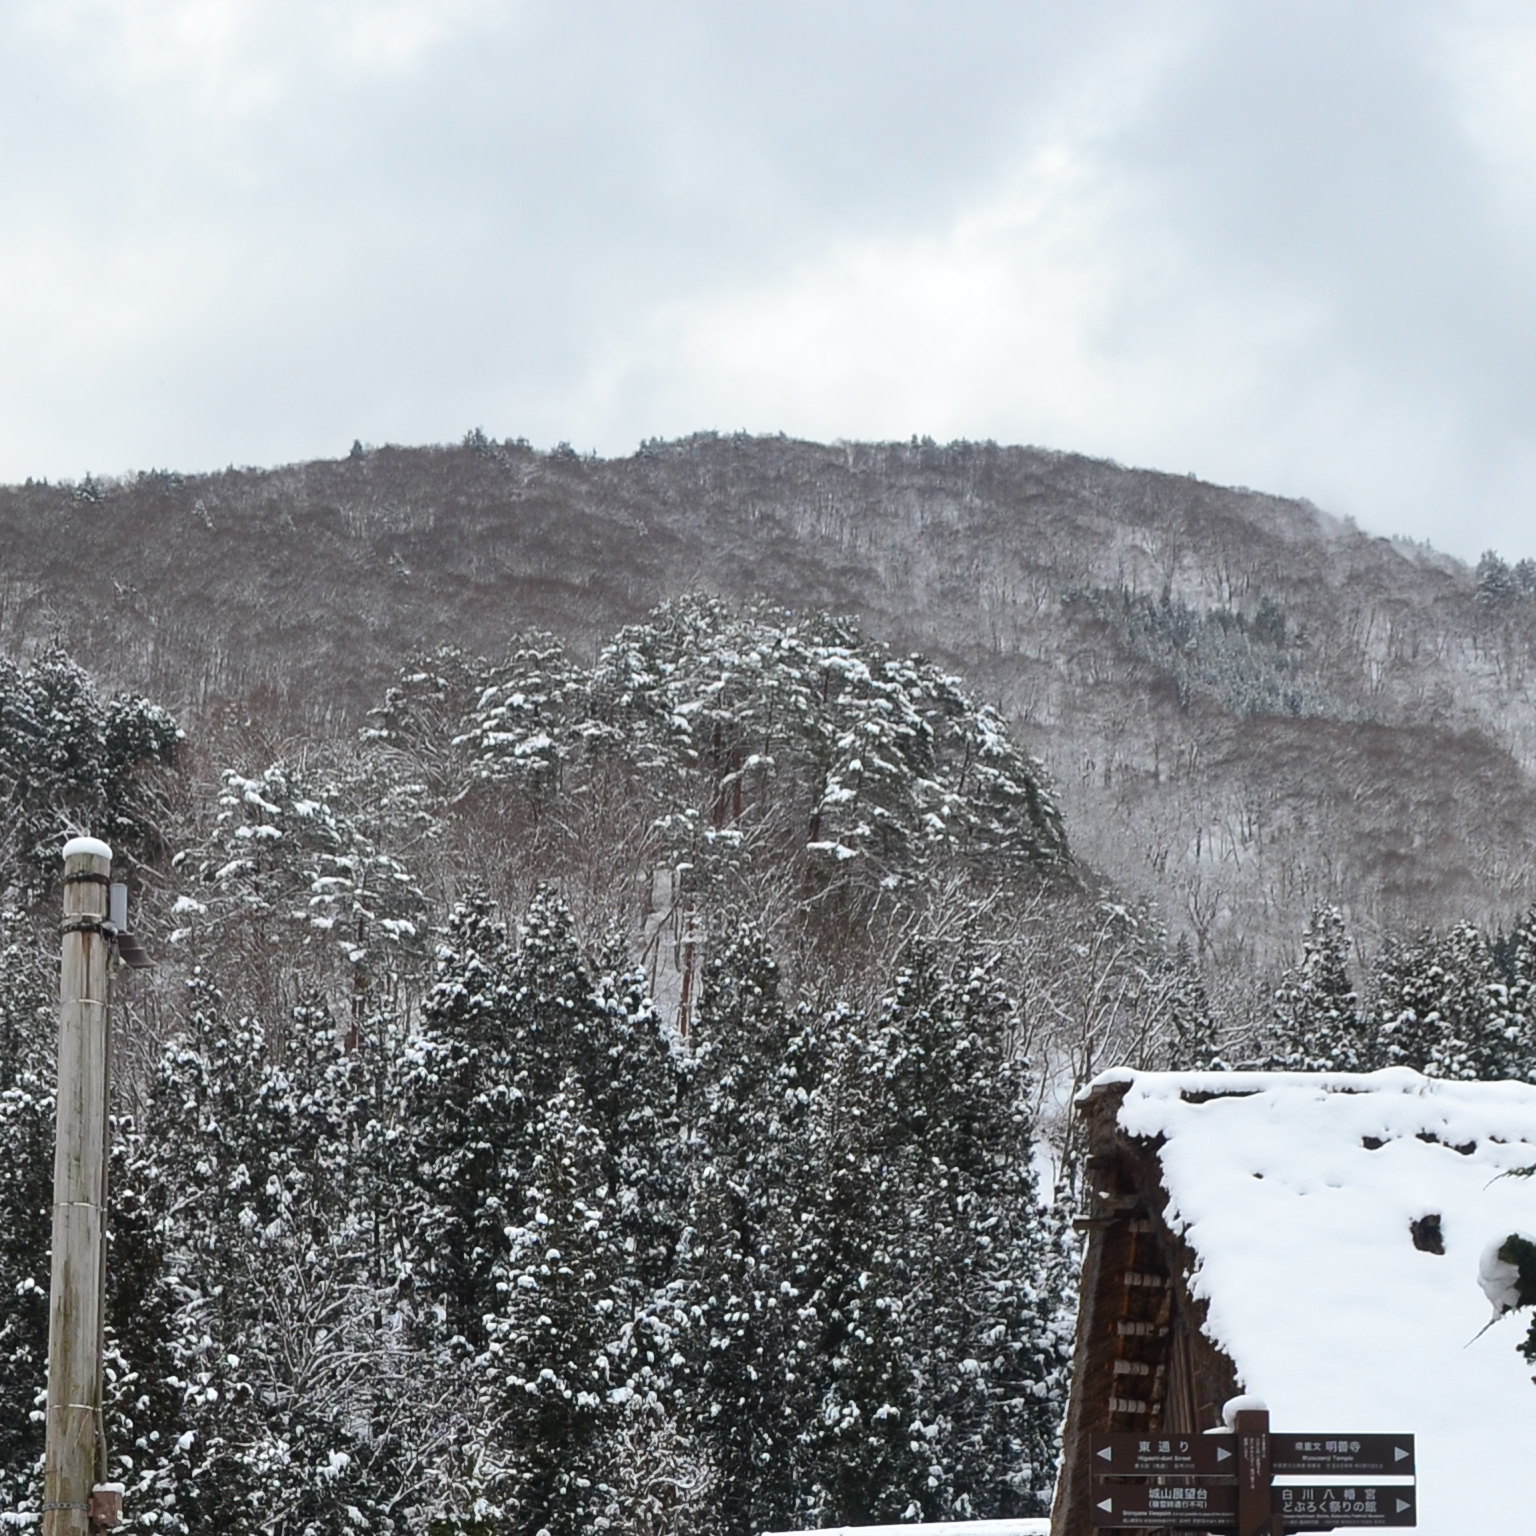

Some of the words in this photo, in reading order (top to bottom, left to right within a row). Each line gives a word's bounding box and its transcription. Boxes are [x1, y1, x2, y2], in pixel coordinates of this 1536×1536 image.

[1138, 1441, 1189, 1453] 東通り
[1325, 1441, 1361, 1453] 明善寺
[1149, 1488, 1207, 1500] 城山展望台
[1283, 1489, 1376, 1500] 白川八幡宮
[1283, 1501, 1377, 1512] どぶろく祭りの館
